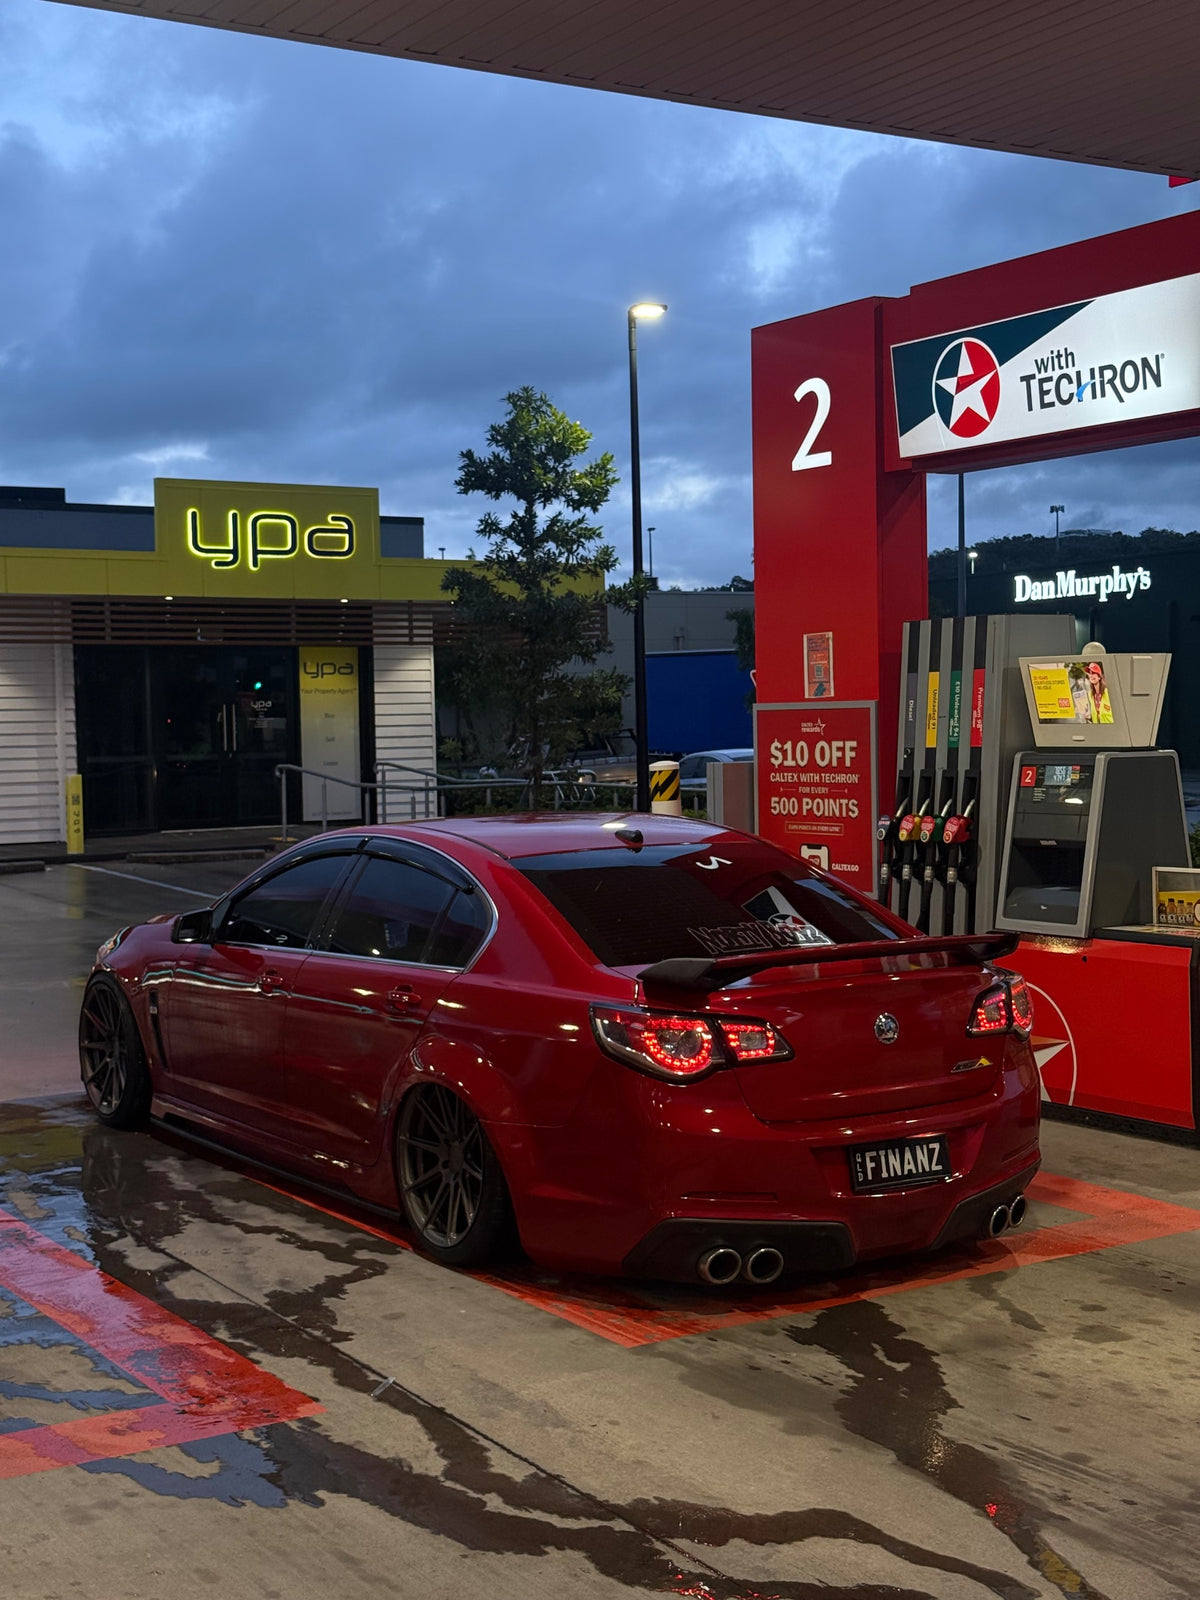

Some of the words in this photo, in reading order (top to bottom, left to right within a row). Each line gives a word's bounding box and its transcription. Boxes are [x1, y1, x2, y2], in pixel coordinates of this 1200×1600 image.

[1034, 347, 1076, 374] with
[791, 377, 832, 471] 2
[187, 509, 355, 570] ypa
[303, 662, 354, 679] ypa
[770, 738, 809, 769] $10
[814, 740, 858, 767] OFF
[770, 772, 799, 783] CALTEX
[800, 773, 820, 783] WITH
[798, 786, 810, 794] FOR
[811, 786, 829, 794] EVERY
[1024, 770, 1033, 783] 2
[770, 797, 799, 816] 500
[802, 798, 859, 819] POINTS
[855, 1153, 864, 1182] QLD
[865, 1142, 943, 1180] FINANZ
